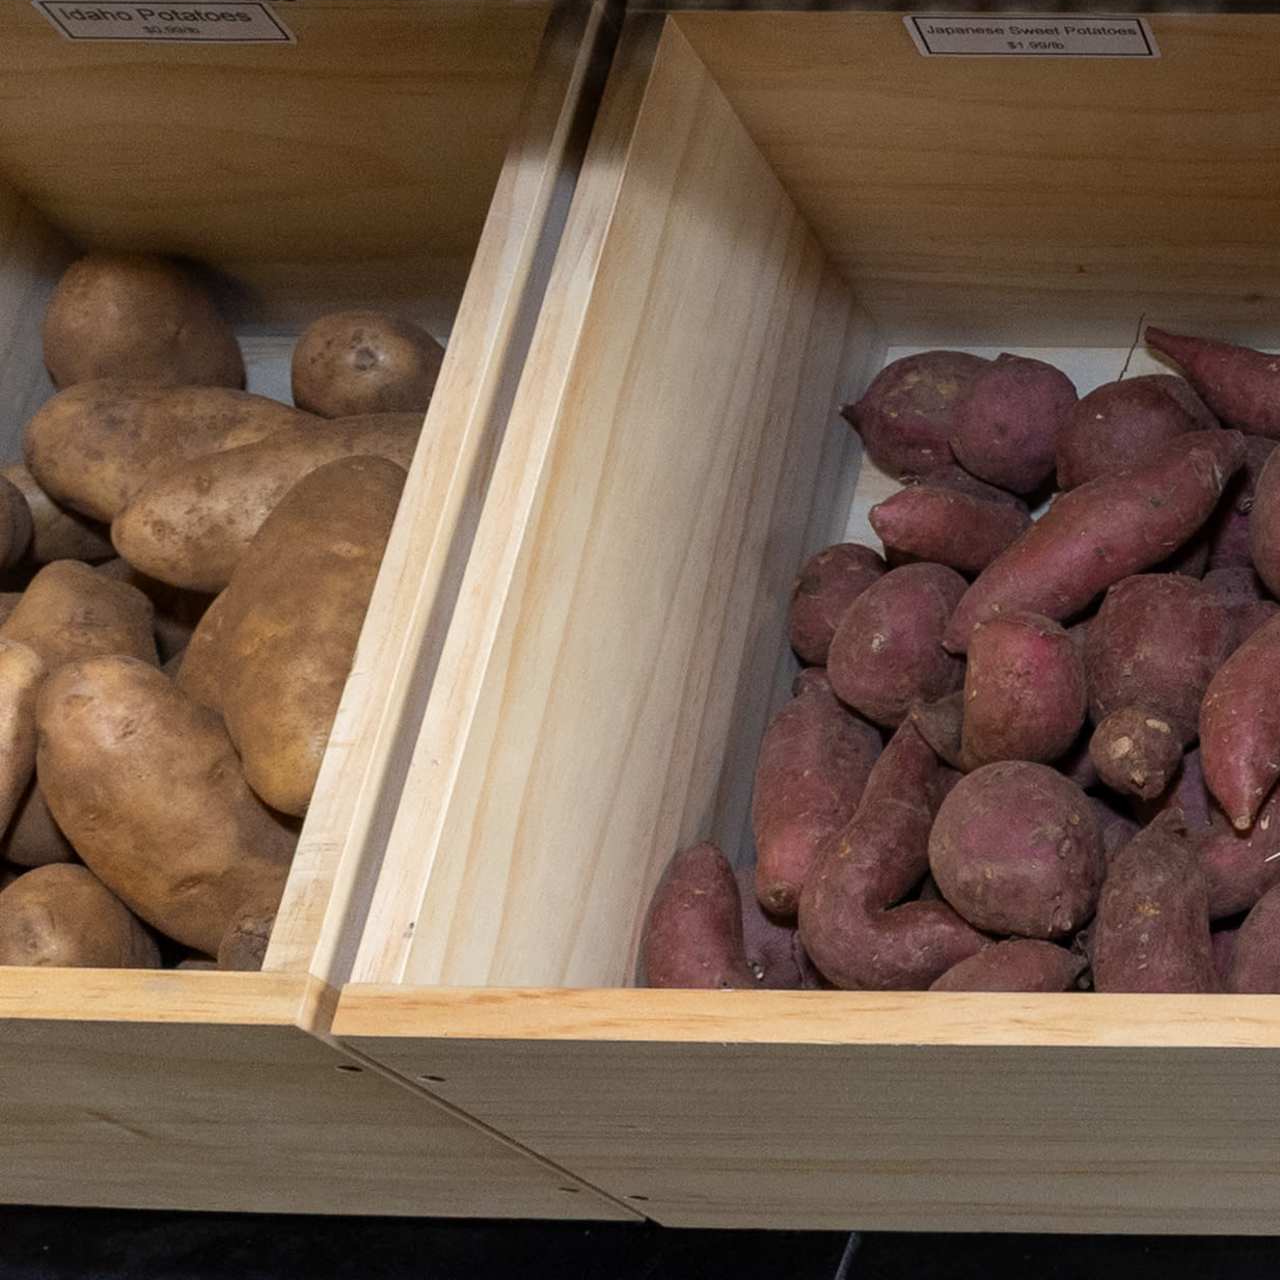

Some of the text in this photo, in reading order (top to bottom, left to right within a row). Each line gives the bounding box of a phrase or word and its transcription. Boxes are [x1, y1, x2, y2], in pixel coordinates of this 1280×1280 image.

[58, 6, 253, 23] Idaho Potatoes
[926, 25, 1137, 36] Japanese Sweet Potatoes
